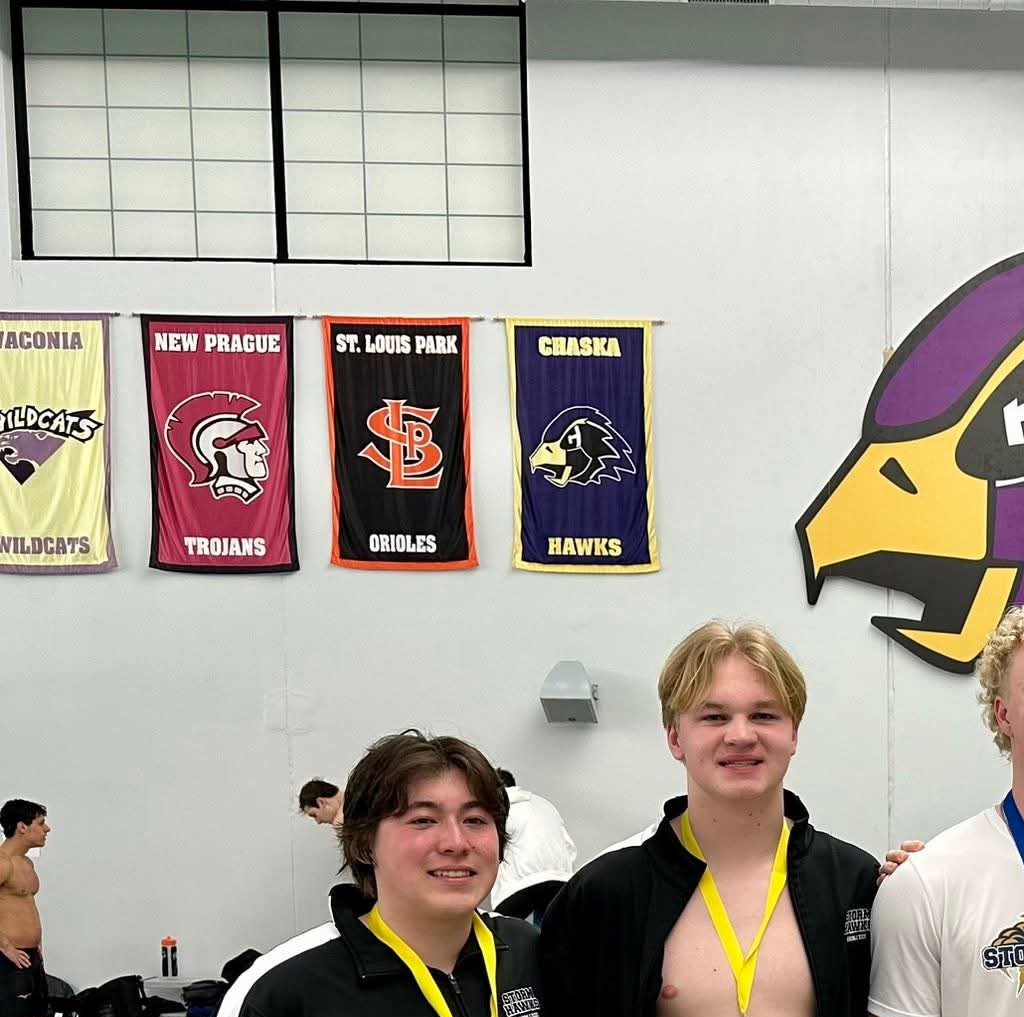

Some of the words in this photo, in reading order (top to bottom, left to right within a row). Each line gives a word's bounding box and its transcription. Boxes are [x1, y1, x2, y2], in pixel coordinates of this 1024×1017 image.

[0, 331, 83, 349] ACONIA
[154, 332, 199, 352] NEW
[204, 333, 281, 353] PRAGUE
[336, 334, 361, 354] ST.
[365, 335, 412, 354] LOUIS
[415, 335, 458, 355] PARK
[538, 336, 622, 357] CHASKA
[184, 536, 266, 557] TROJANS
[369, 533, 437, 554] ORIOLES
[547, 537, 622, 558] HAWKS
[502, 987, 535, 1005] STORM
[503, 999, 540, 1017] HAWKS
